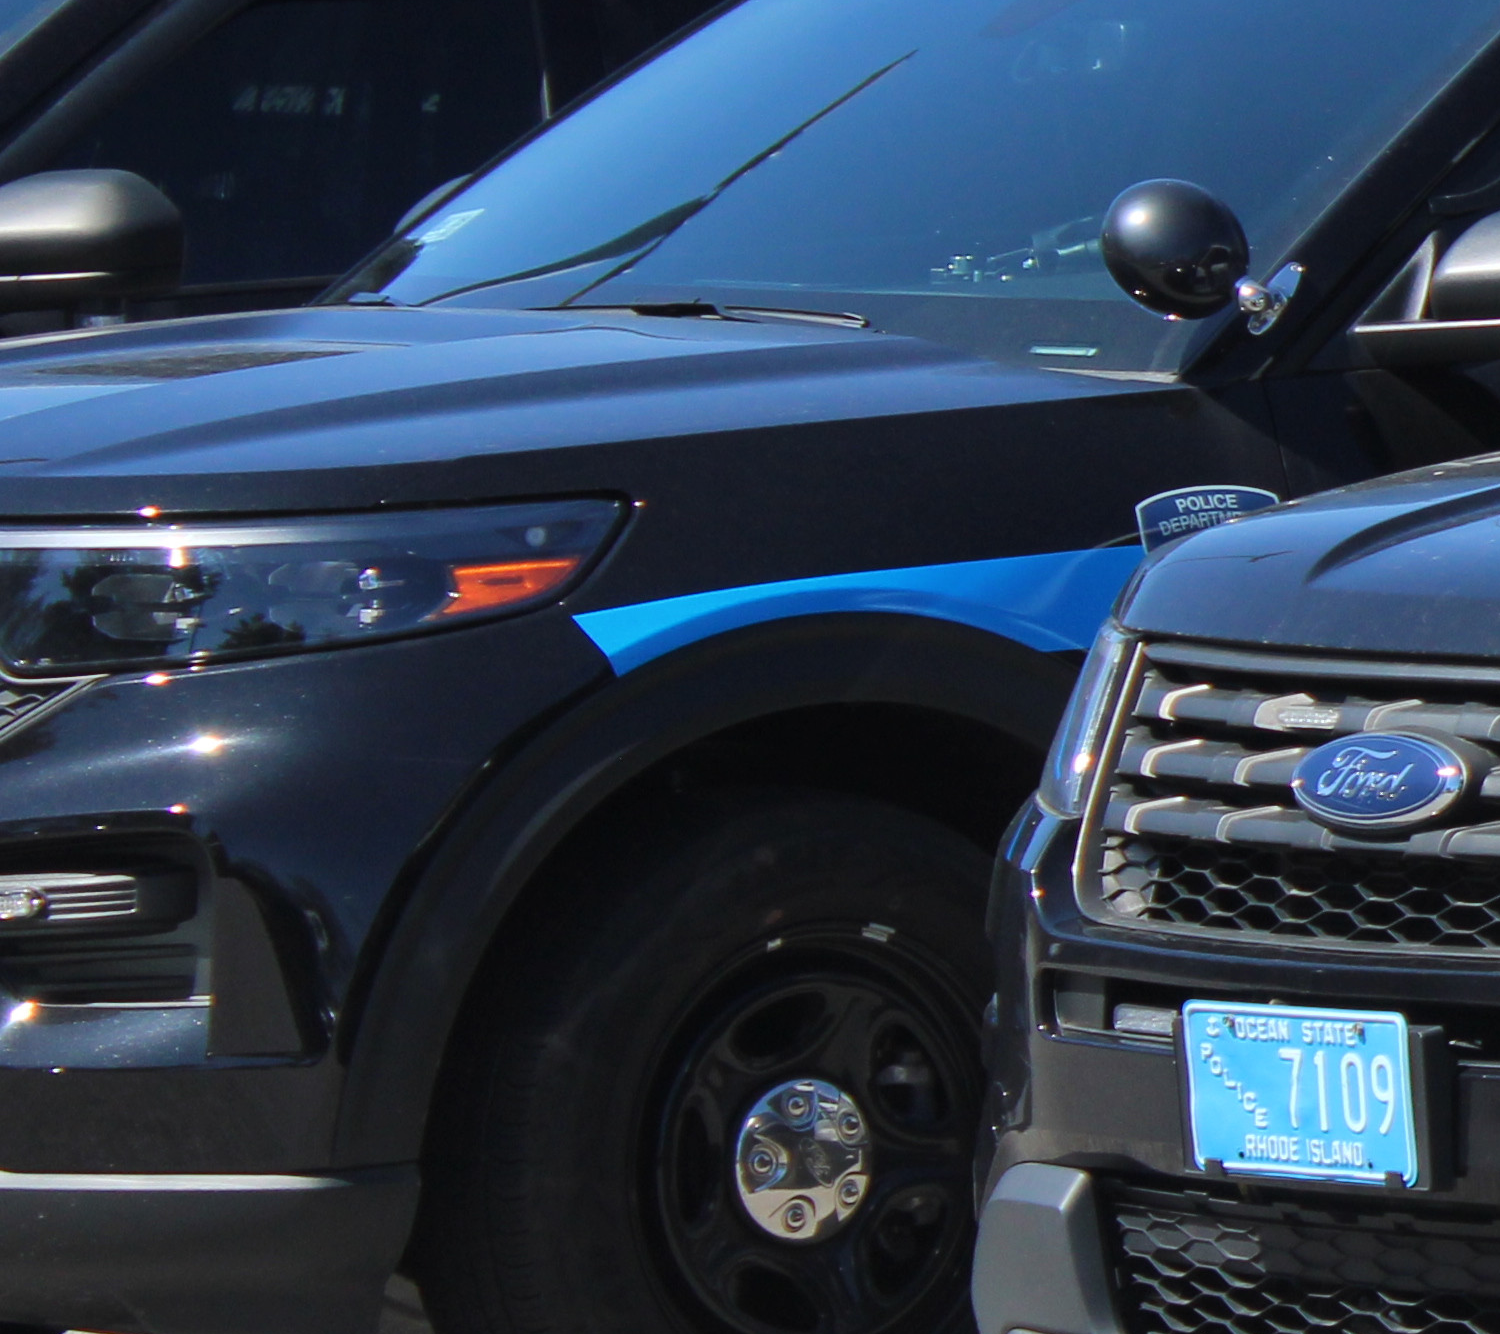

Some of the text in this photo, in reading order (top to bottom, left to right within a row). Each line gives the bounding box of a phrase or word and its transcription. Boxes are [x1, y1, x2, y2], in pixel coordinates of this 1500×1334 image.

[1175, 494, 1239, 514] POLICE
[1158, 511, 1243, 537] DEPARTM
[1316, 745, 1415, 799] Ford
[1235, 1019, 1357, 1046] OCEAN STATE
[1200, 1043, 1269, 1129] POLICE
[1278, 1047, 1395, 1135] 7109
[1246, 1134, 1364, 1166] RHODE ISLAND
